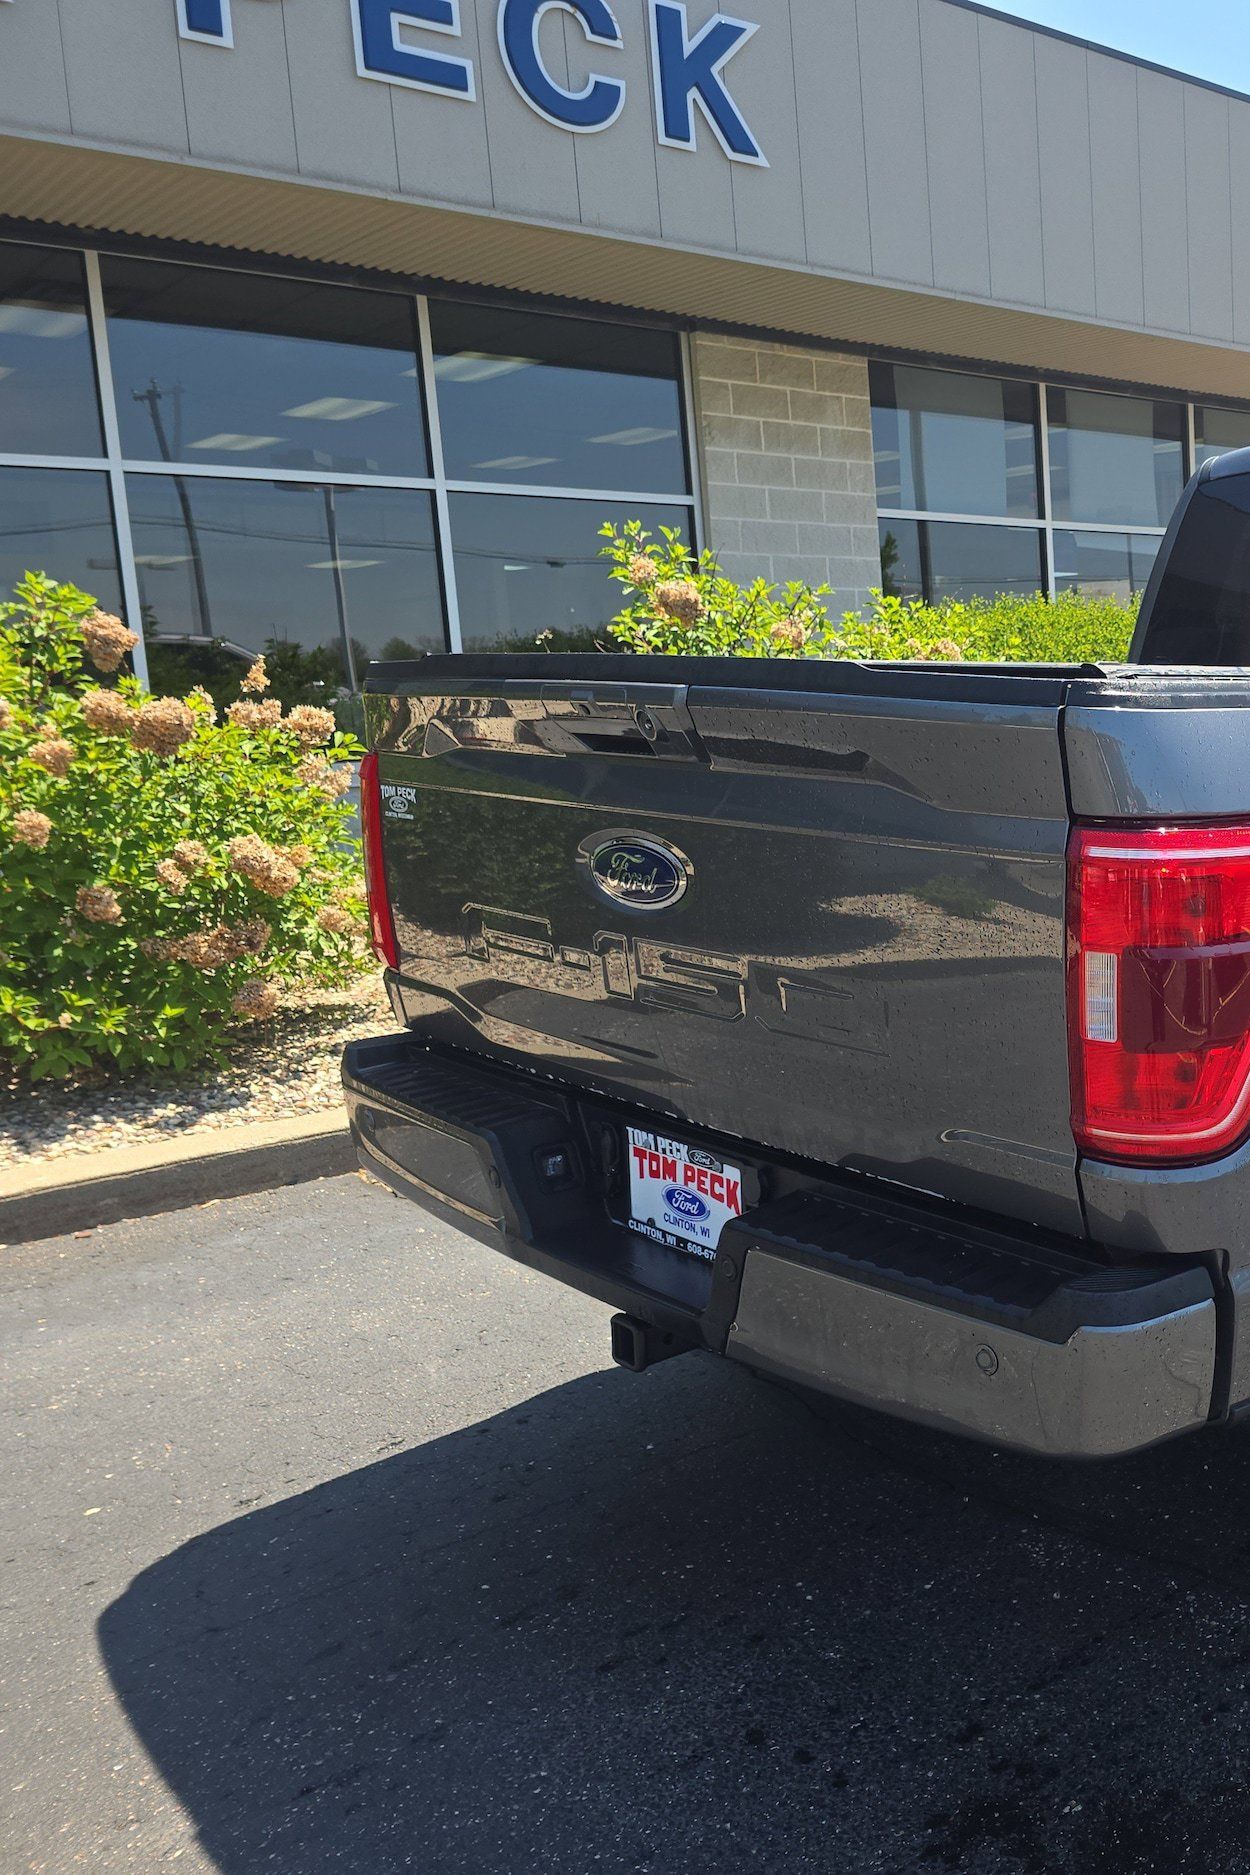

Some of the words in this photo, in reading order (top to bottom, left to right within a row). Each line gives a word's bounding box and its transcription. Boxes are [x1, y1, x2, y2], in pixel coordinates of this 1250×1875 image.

[380, 784, 396, 799] TOM
[397, 787, 416, 803] PECK
[607, 852, 659, 893] Ford
[625, 1126, 655, 1151] TOM
[657, 1136, 690, 1163] PECK
[693, 1151, 711, 1166] Ford
[633, 1146, 677, 1183] TOM
[683, 1163, 743, 1216] PECK
[672, 1189, 700, 1215] Ford
[628, 1219, 665, 1243] CLINTON,
[666, 1233, 677, 1246] WI
[687, 1241, 717, 1260] 608-67
[663, 1212, 698, 1236] CLINTON,
[700, 1227, 710, 1239] WI
